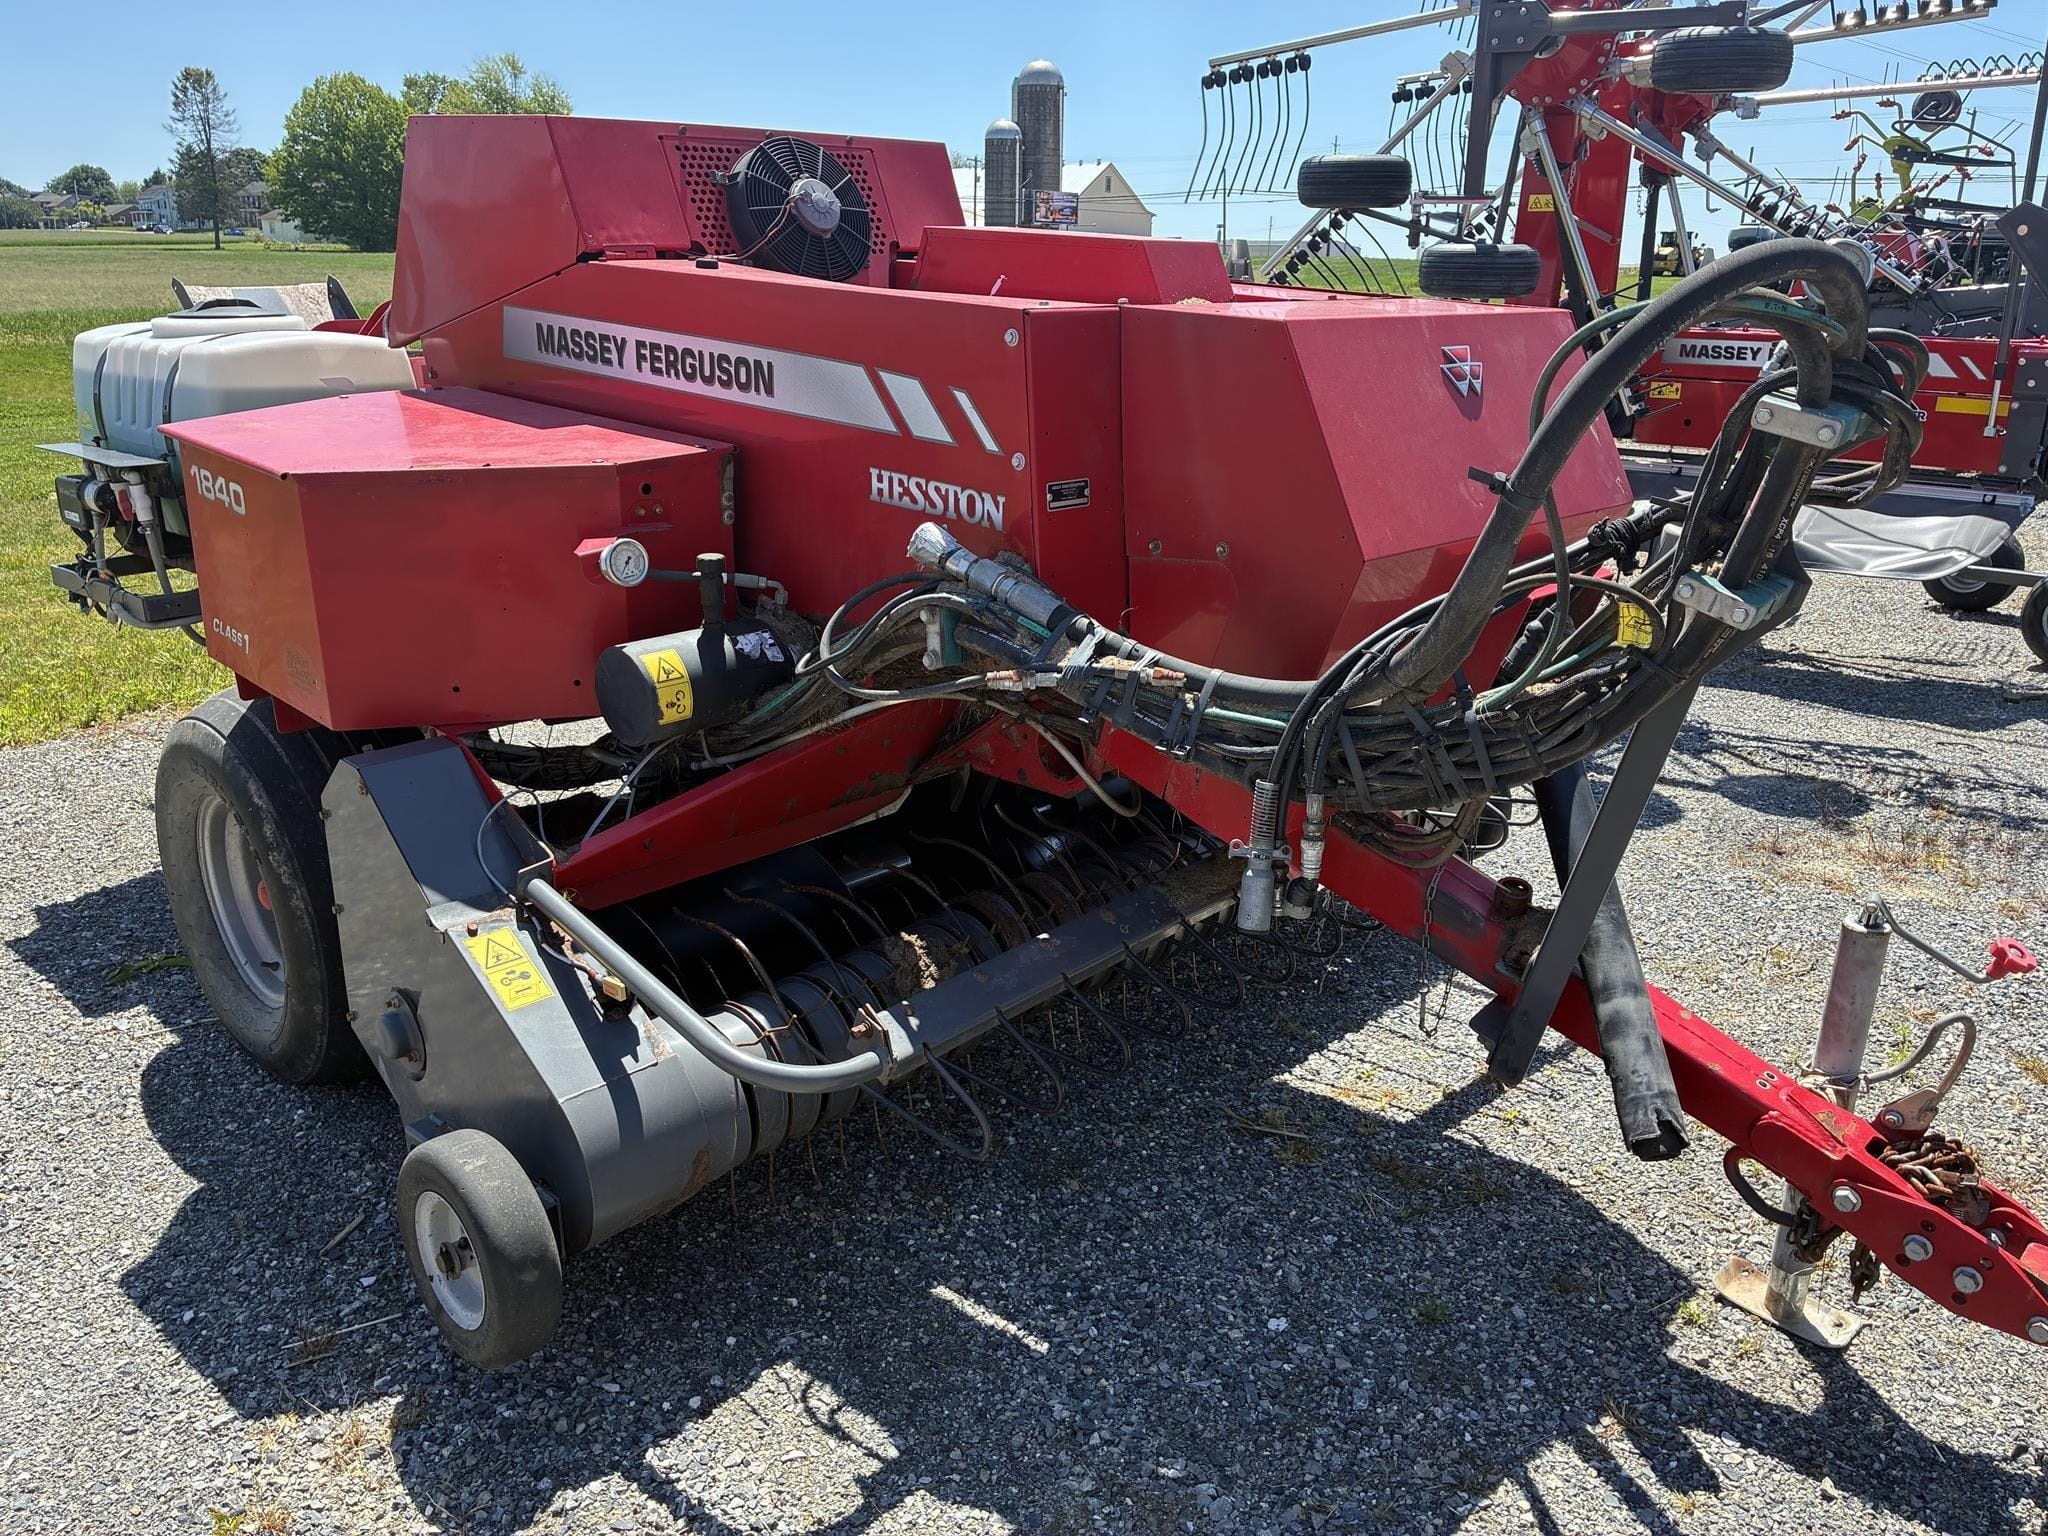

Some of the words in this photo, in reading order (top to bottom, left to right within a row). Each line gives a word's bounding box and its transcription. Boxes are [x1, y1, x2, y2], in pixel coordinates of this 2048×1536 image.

[535, 322, 628, 369] MASSEY
[634, 338, 775, 398] FERGUSON
[1679, 343, 1762, 361] MASSEY
[190, 464, 246, 516] 1840
[869, 467, 1006, 532] HESSTON
